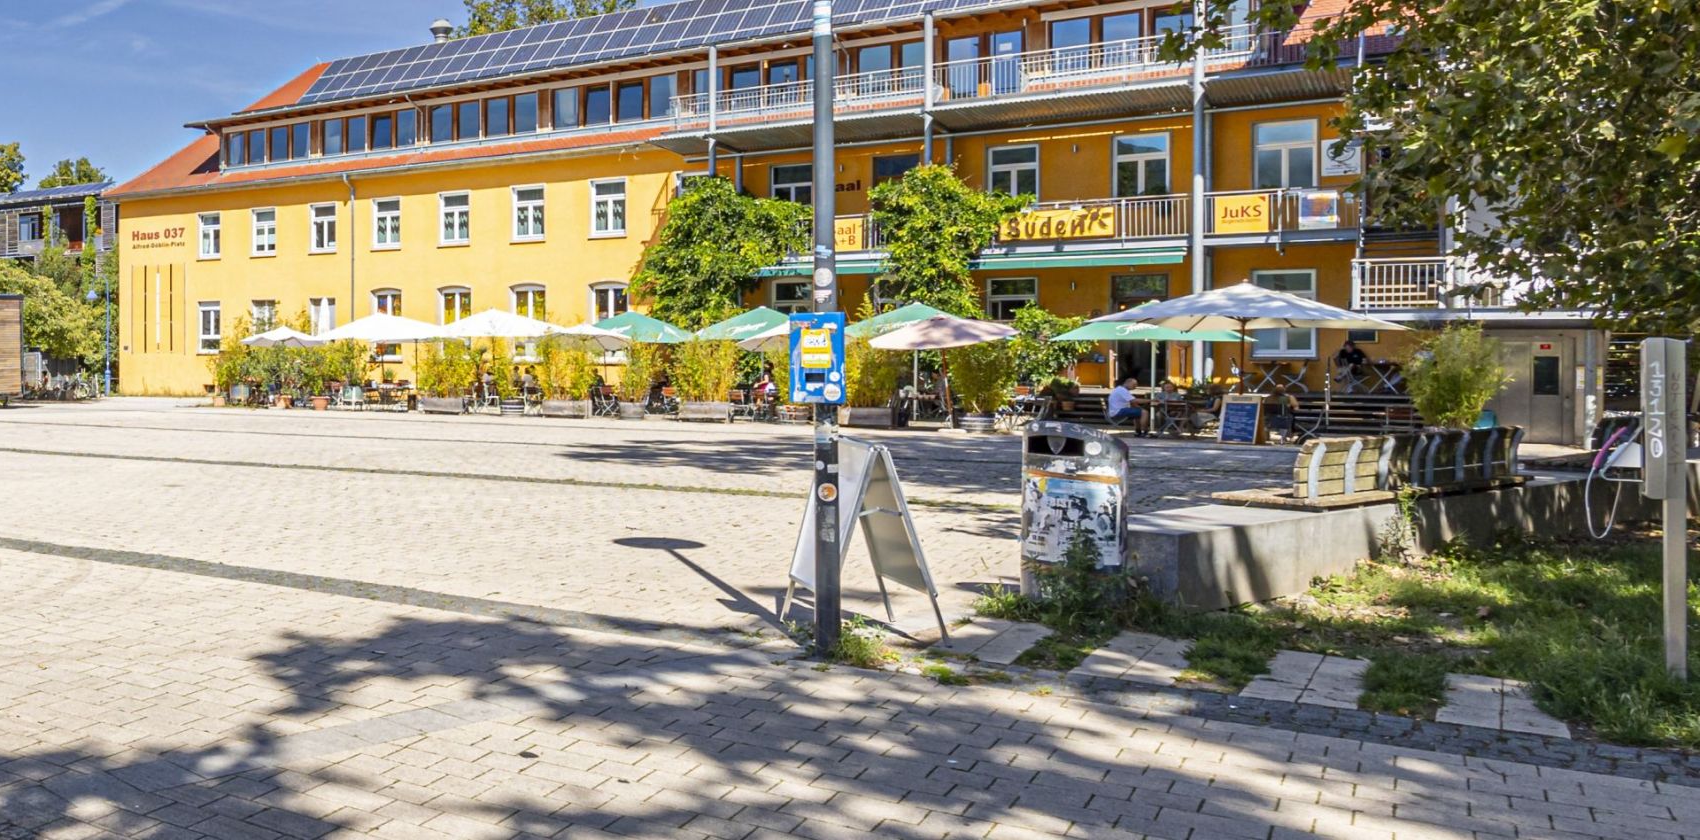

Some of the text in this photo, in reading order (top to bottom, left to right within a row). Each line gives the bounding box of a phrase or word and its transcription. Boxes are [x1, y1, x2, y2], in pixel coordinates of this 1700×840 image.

[835, 180, 861, 192] aal
[1221, 205, 1262, 219] JuKS
[132, 227, 185, 242] Haus 037
